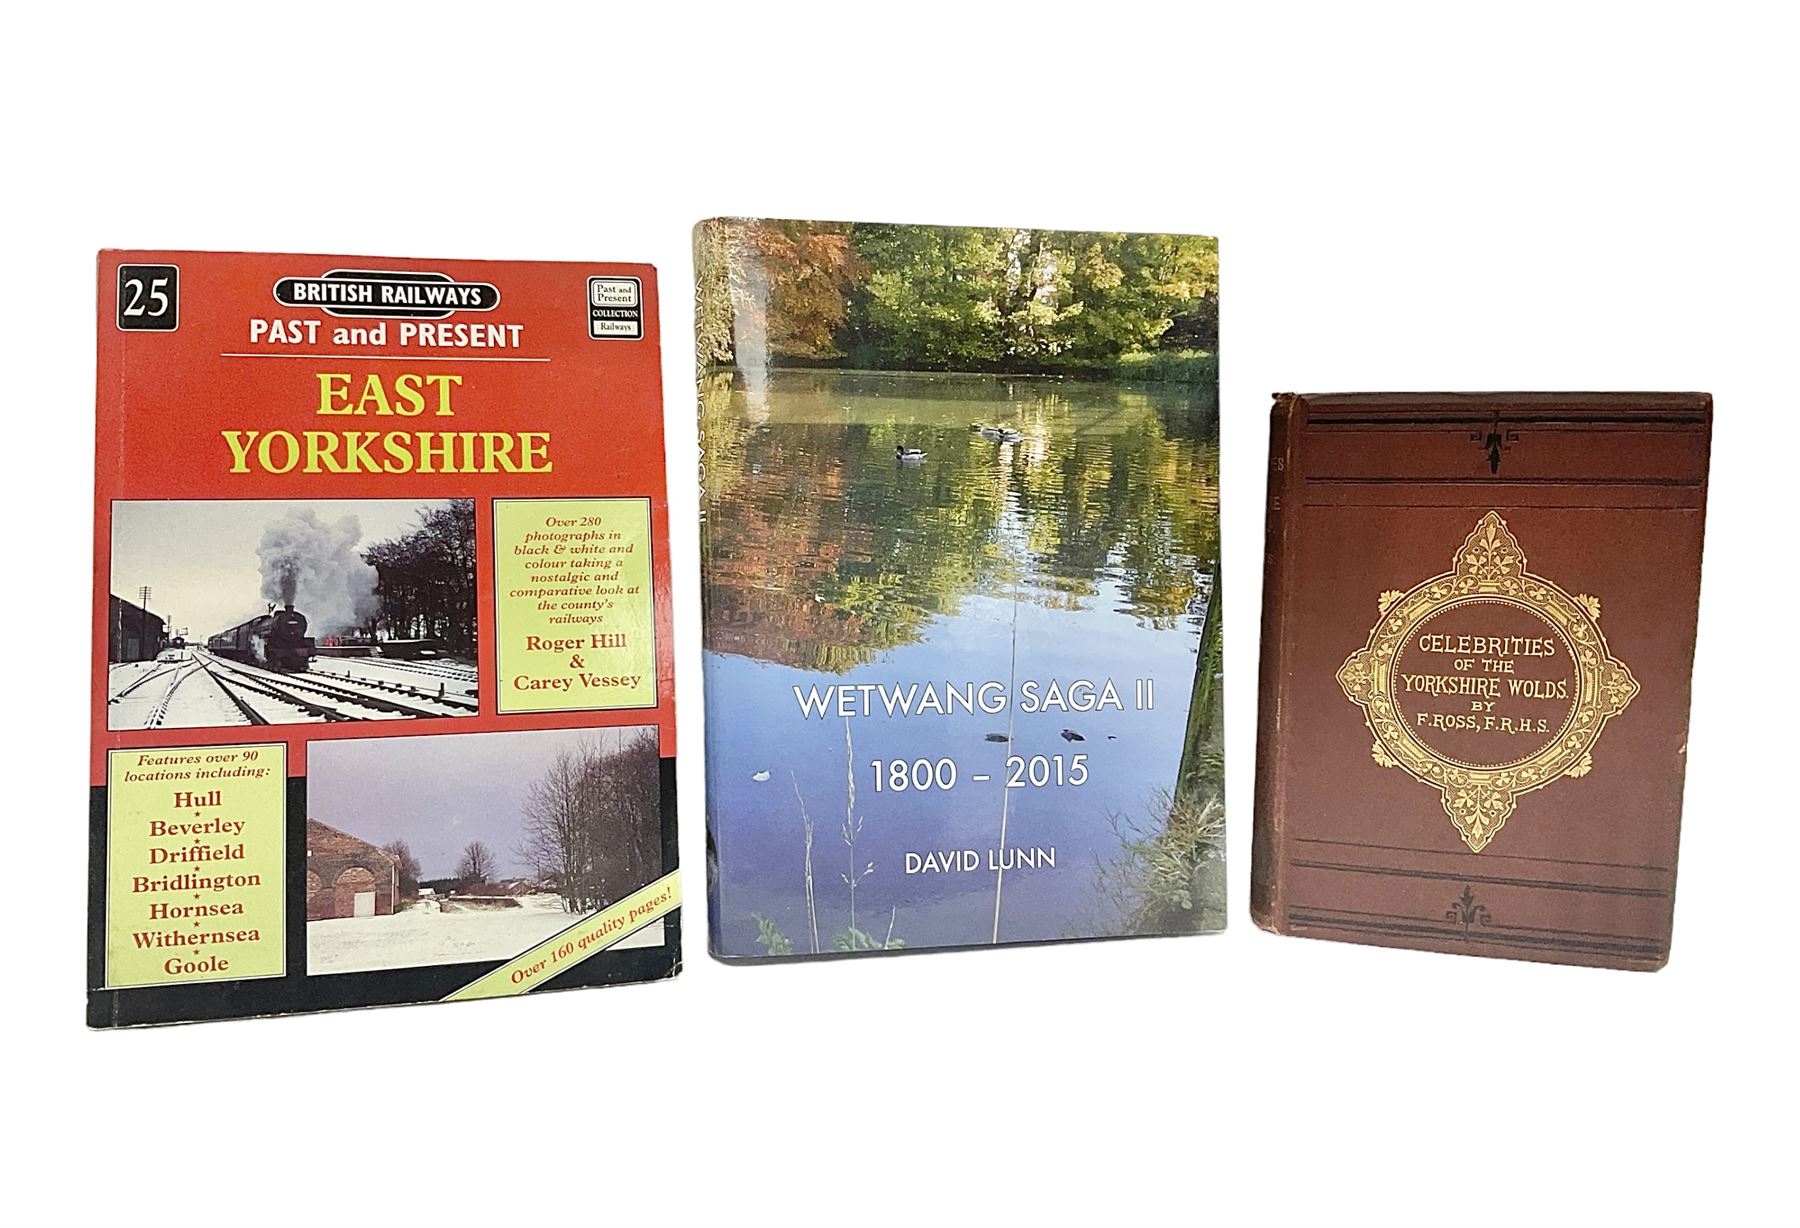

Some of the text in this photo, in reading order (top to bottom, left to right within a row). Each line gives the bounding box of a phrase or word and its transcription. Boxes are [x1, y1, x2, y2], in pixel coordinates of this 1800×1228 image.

[123, 277, 169, 317] 25
[293, 283, 482, 306] BRITISH RAILWAYS
[597, 284, 616, 293] Past
[597, 293, 632, 302] Present
[592, 309, 639, 318] COLLECTION
[250, 320, 524, 348] PAST and PRESENT
[600, 322, 631, 332] Railways
[315, 372, 463, 416] EAST
[220, 430, 553, 474] YORKSHIRE
[545, 516, 602, 528] Over 280
[525, 530, 621, 544] photographs in
[514, 544, 634, 556] black & white and
[525, 558, 624, 570] colour taking a
[531, 571, 619, 584] nostalgic and
[509, 585, 640, 600] comparative look at
[537, 599, 614, 611] the county's
[549, 614, 603, 625] railways
[526, 633, 627, 653] Roger Hill
[1419, 634, 1555, 657] CELEBRITIES
[569, 654, 585, 669] &
[1454, 659, 1514, 673] OF THE
[513, 673, 641, 692] Carey Vessey
[1401, 674, 1569, 699] YORKSHIRE WOLDS.
[792, 678, 1154, 720] WETWANG SAGA II
[1471, 702, 1495, 712] BY
[138, 750, 258, 766] Features over 90
[124, 766, 271, 782] locations including:
[870, 757, 957, 792] 1800
[1005, 754, 1089, 788] 2015
[174, 790, 222, 808] Hull
[149, 818, 246, 837] Beverley
[149, 843, 245, 865] Driffield
[905, 847, 1056, 874] DAVID LUNN
[132, 873, 261, 893] Bridlington
[149, 901, 244, 920] Hornsea
[132, 929, 260, 949] Withernsea
[511, 886, 672, 984] Over 160 quality pages!
[163, 956, 229, 975] Goole
